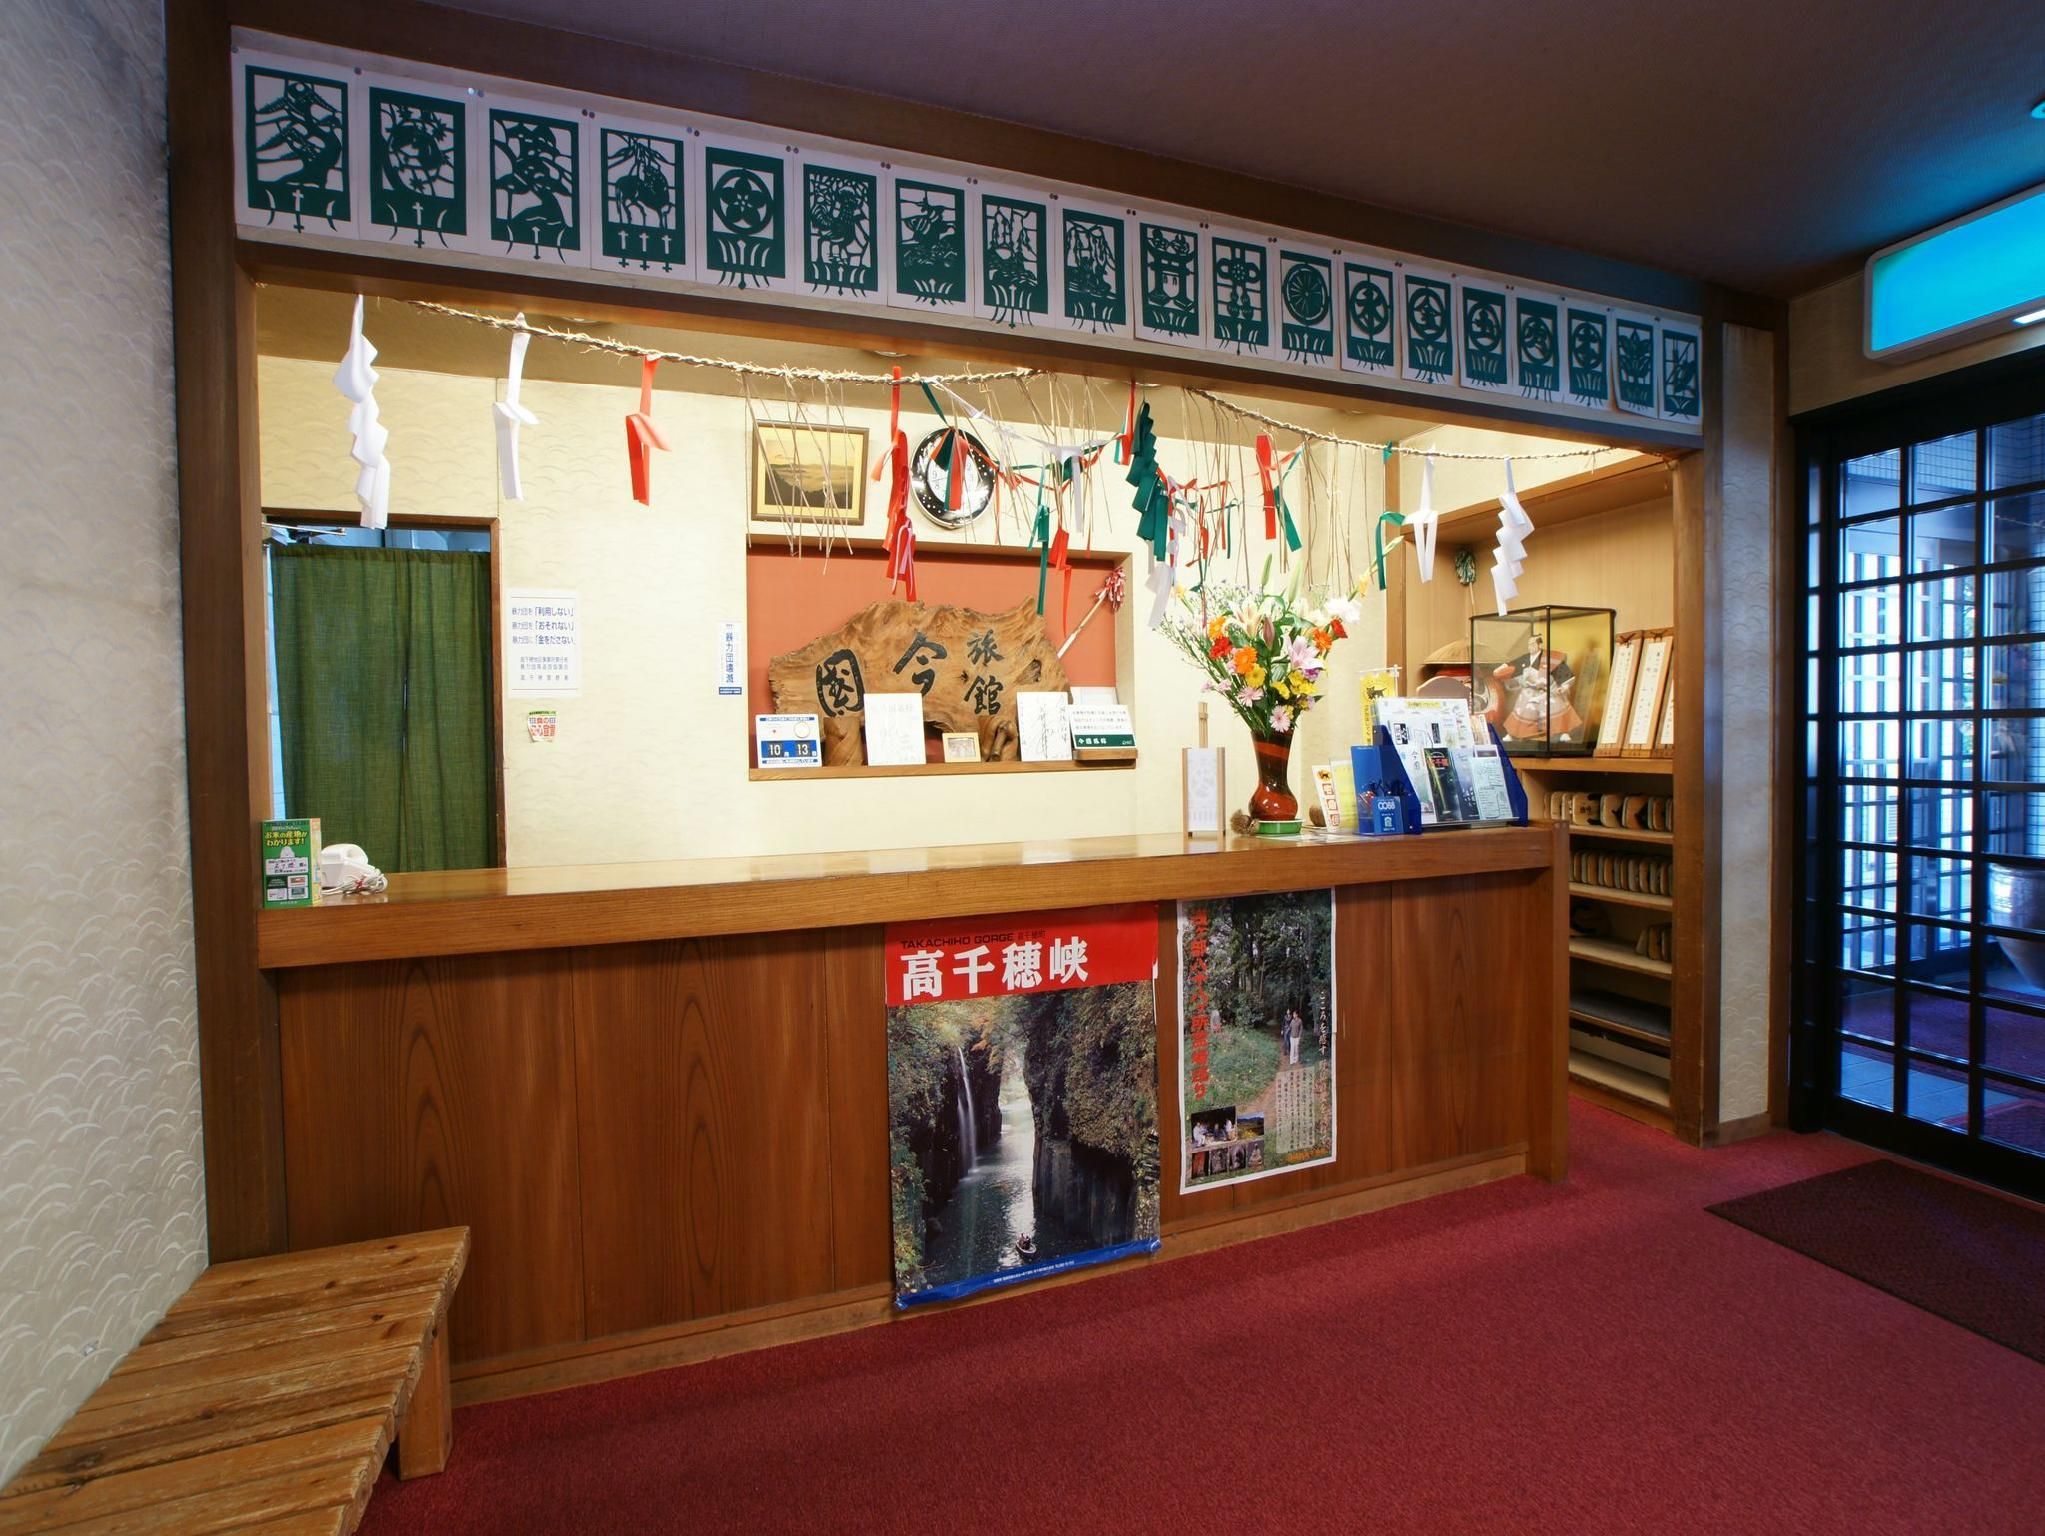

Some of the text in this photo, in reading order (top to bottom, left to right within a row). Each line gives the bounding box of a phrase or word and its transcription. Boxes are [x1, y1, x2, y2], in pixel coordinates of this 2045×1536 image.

[769, 744, 781, 756] 10
[797, 743, 809, 755] 13
[901, 935, 971, 950] TAKACHIHO
[974, 932, 1014, 945] GORGE
[900, 935, 1089, 1001] 高千穂峡
